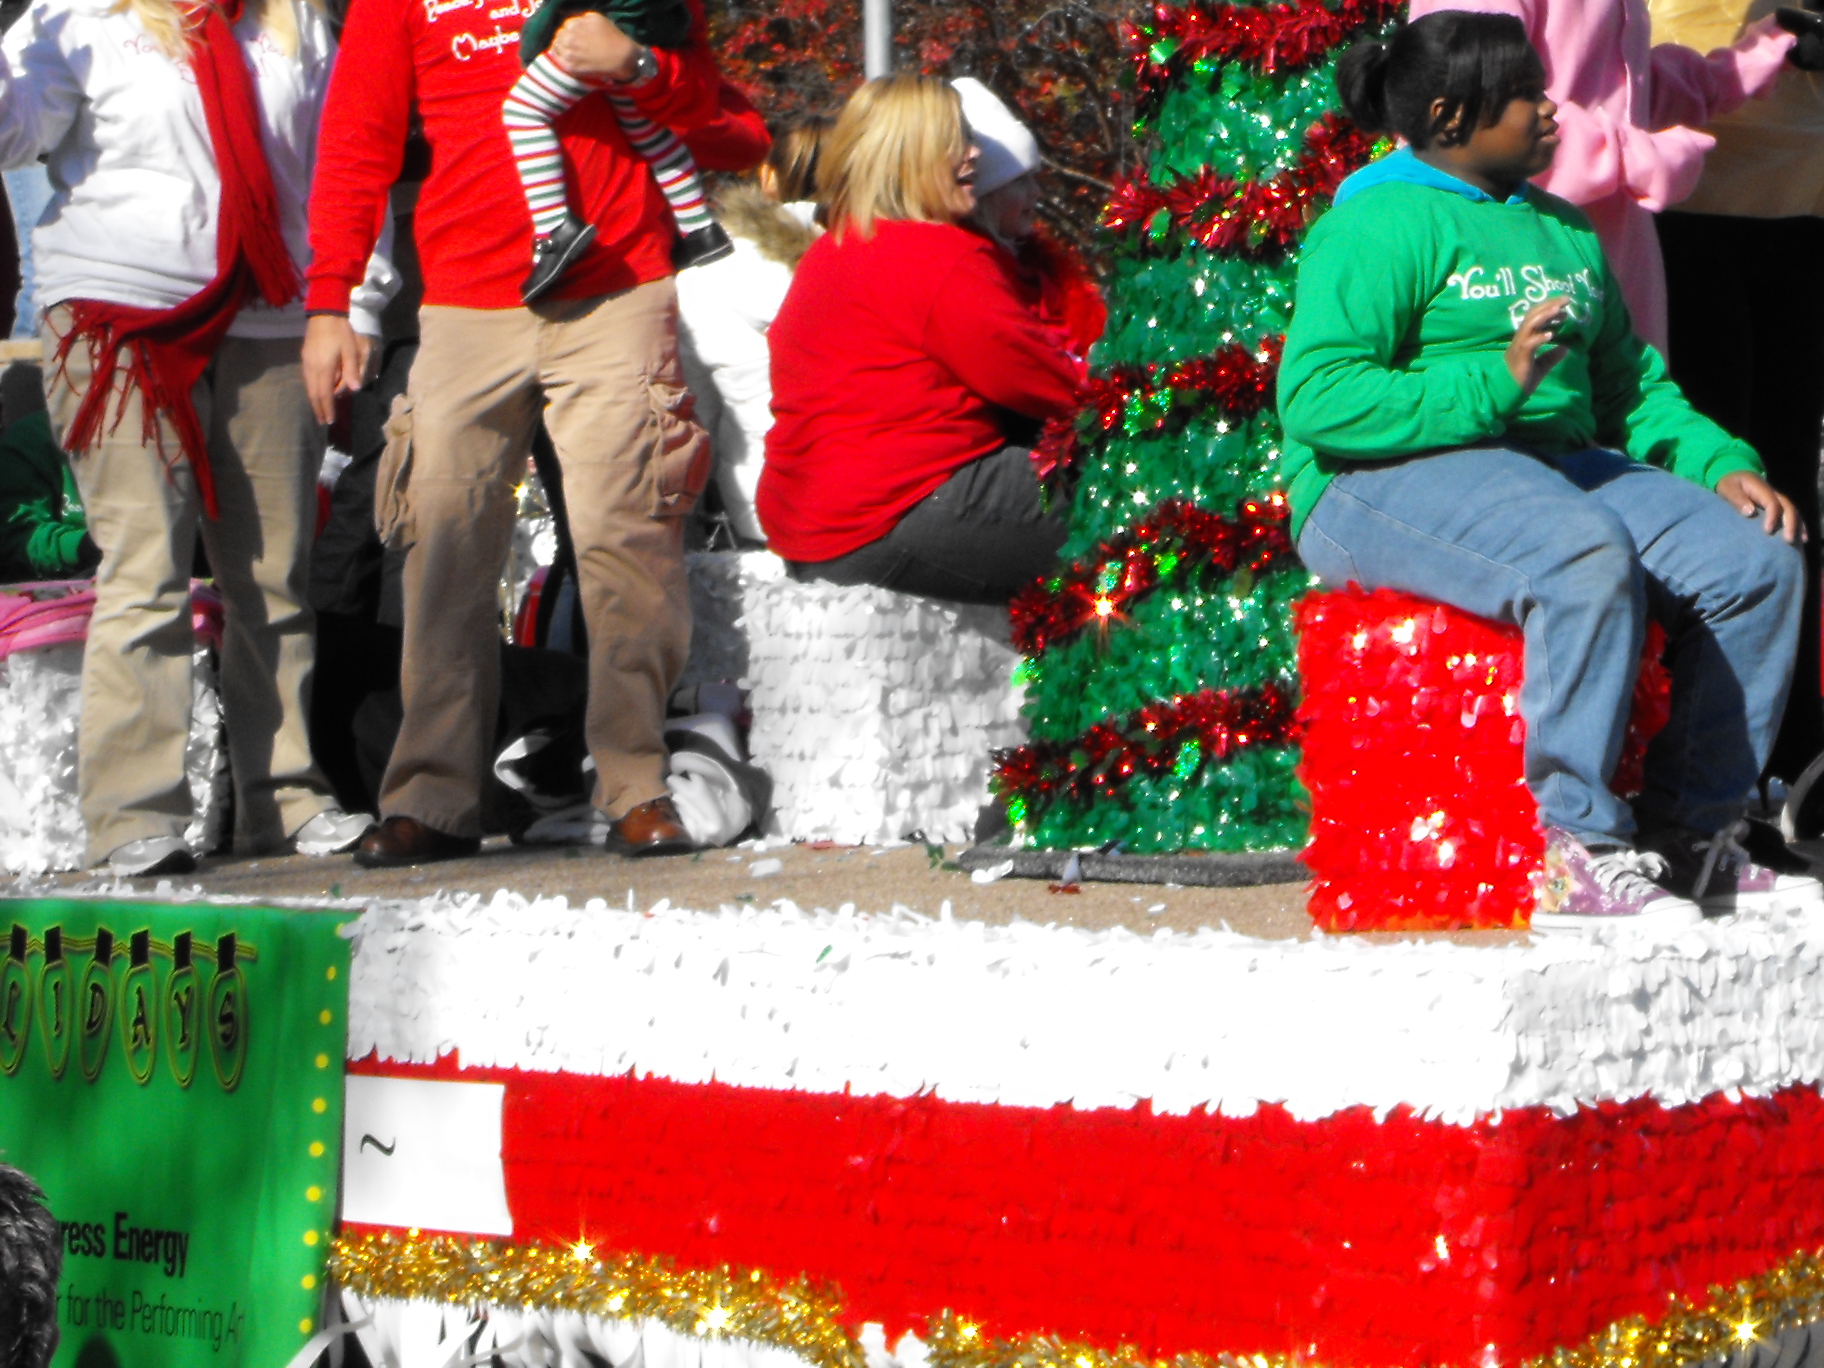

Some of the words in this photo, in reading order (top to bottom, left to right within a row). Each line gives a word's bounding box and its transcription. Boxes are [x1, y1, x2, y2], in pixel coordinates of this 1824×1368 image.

[451, 24, 520, 61] Maybe
[1447, 266, 1517, 300] You'll
[113, 1211, 190, 1279] Energy
[66, 1283, 91, 1326] for
[95, 1286, 126, 1331] the
[131, 1290, 223, 1353] Performing
